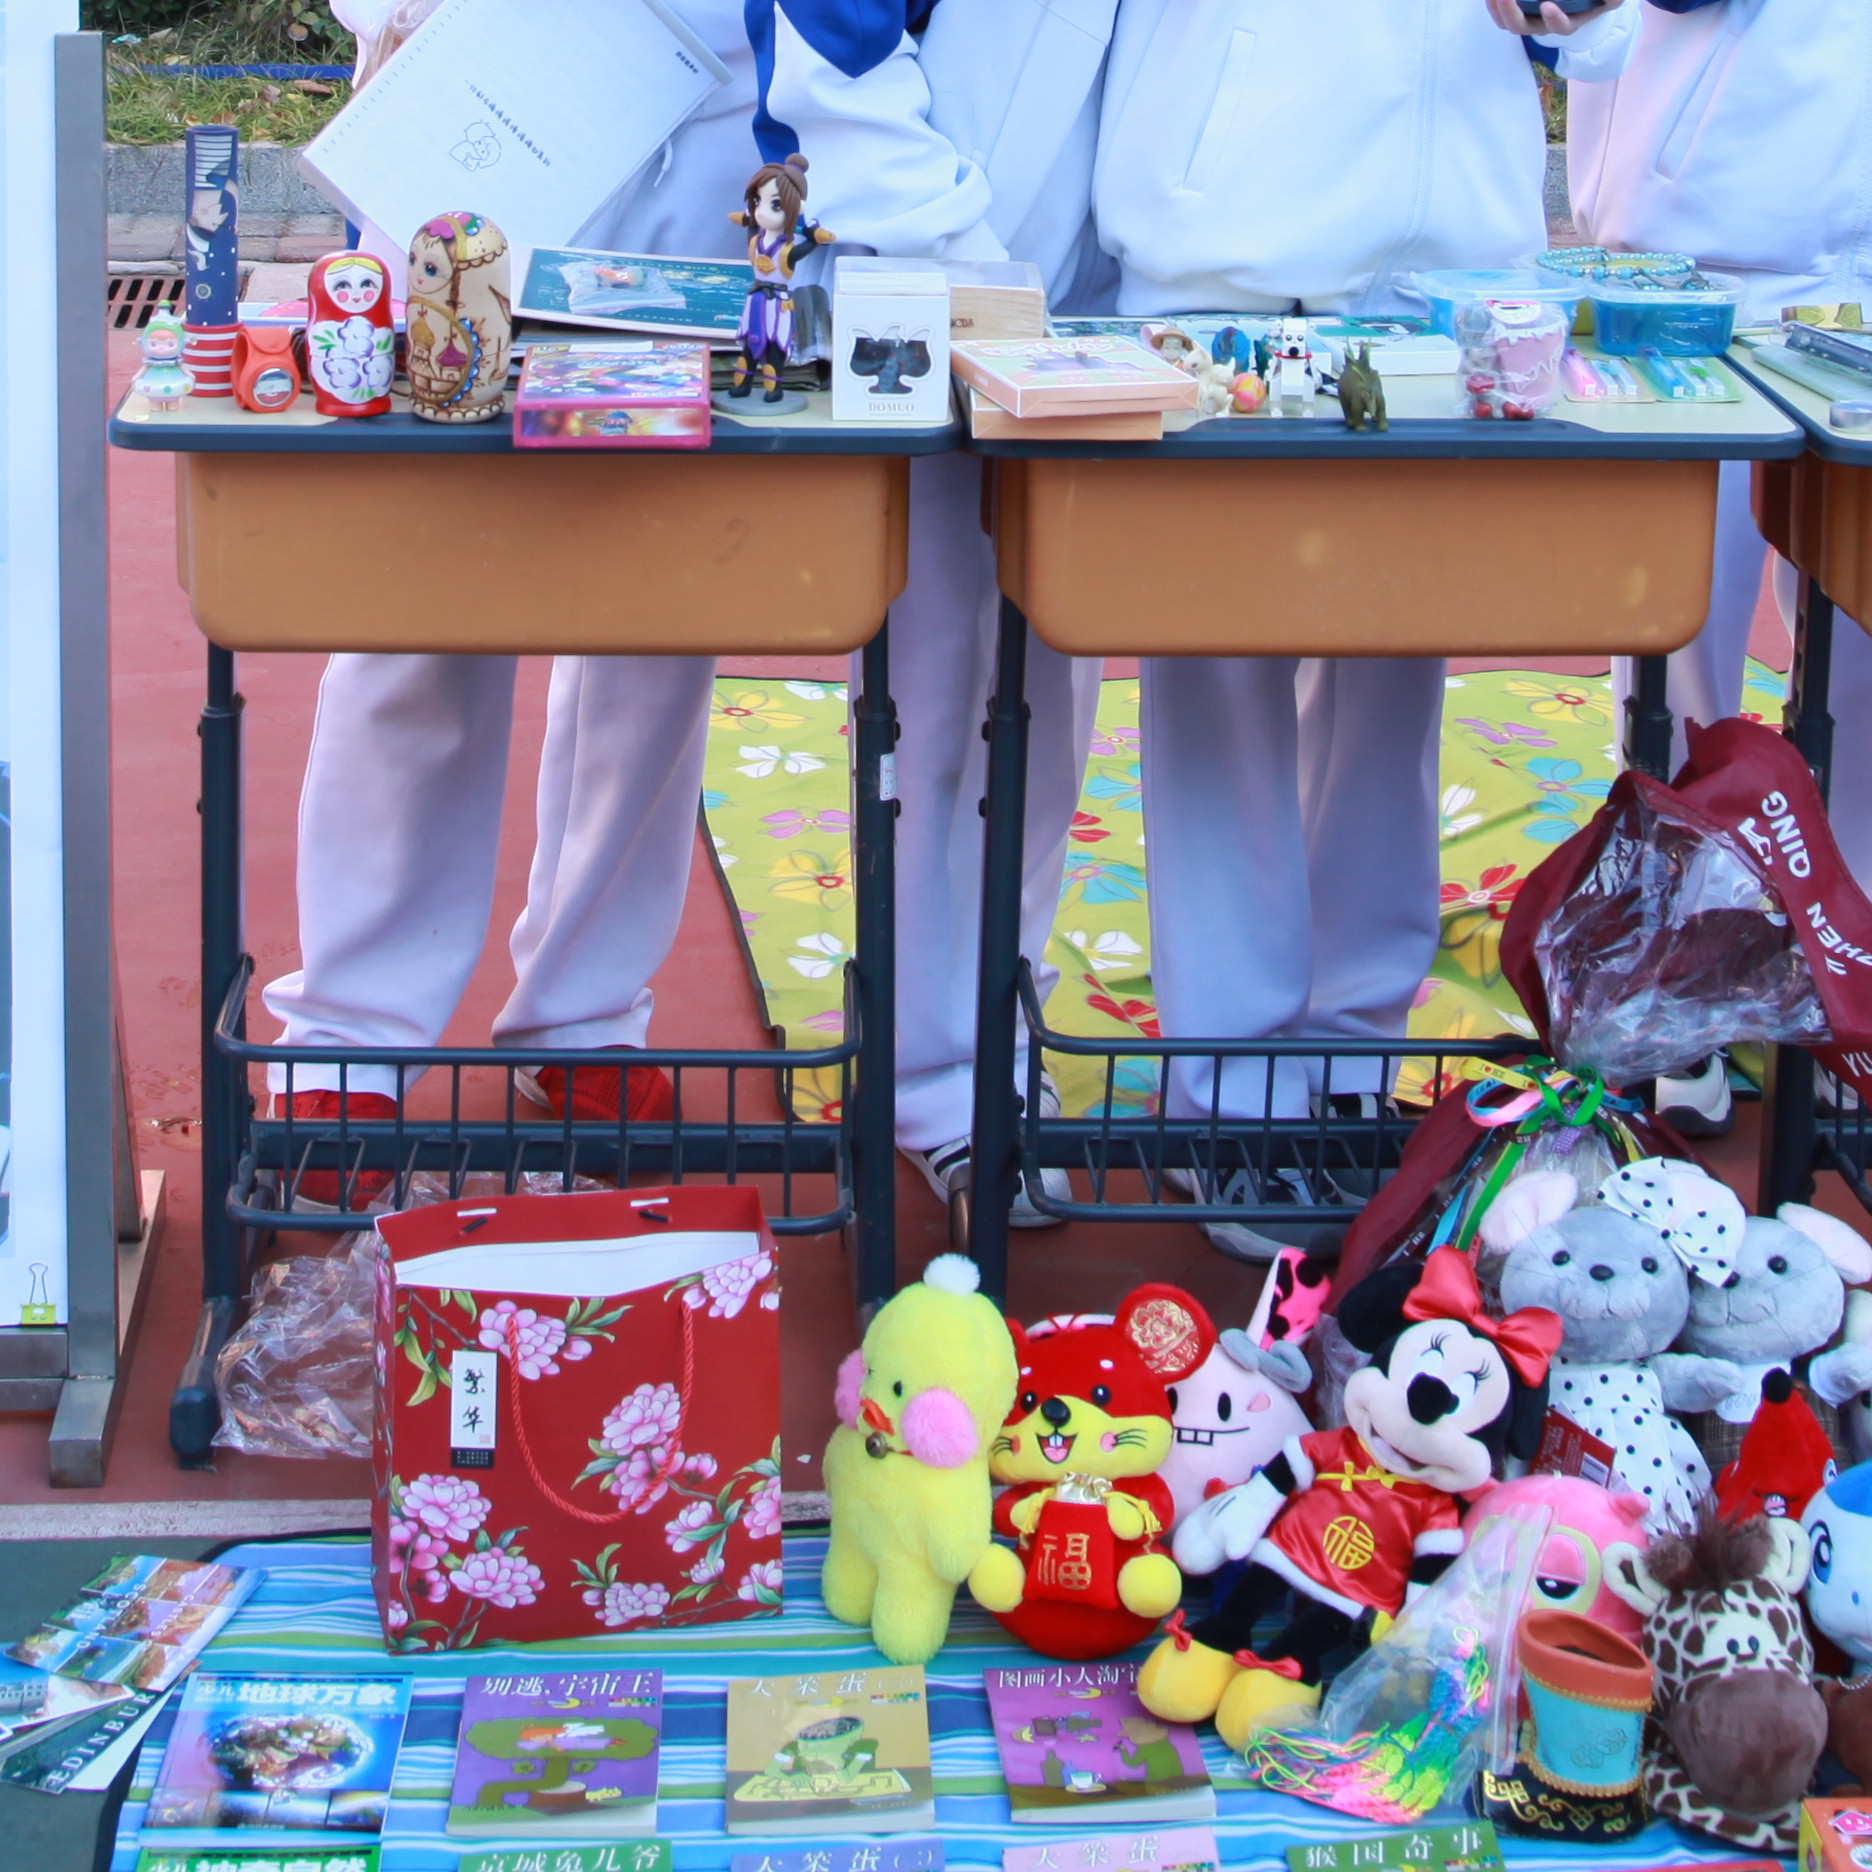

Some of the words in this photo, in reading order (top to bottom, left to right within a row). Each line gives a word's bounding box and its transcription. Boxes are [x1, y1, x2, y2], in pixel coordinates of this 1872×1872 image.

[868, 402, 916, 412] DOMUO
[1761, 789, 1812, 880] QING
[462, 1367, 486, 1434] 繁华
[1037, 1532, 1093, 1591] 福
[1323, 1515, 1375, 1571] 福
[76, 1582, 148, 1649] SCOTLAND
[237, 1682, 397, 1705] 地球万象
[1305, 1826, 1482, 1868] 猴国奇事
